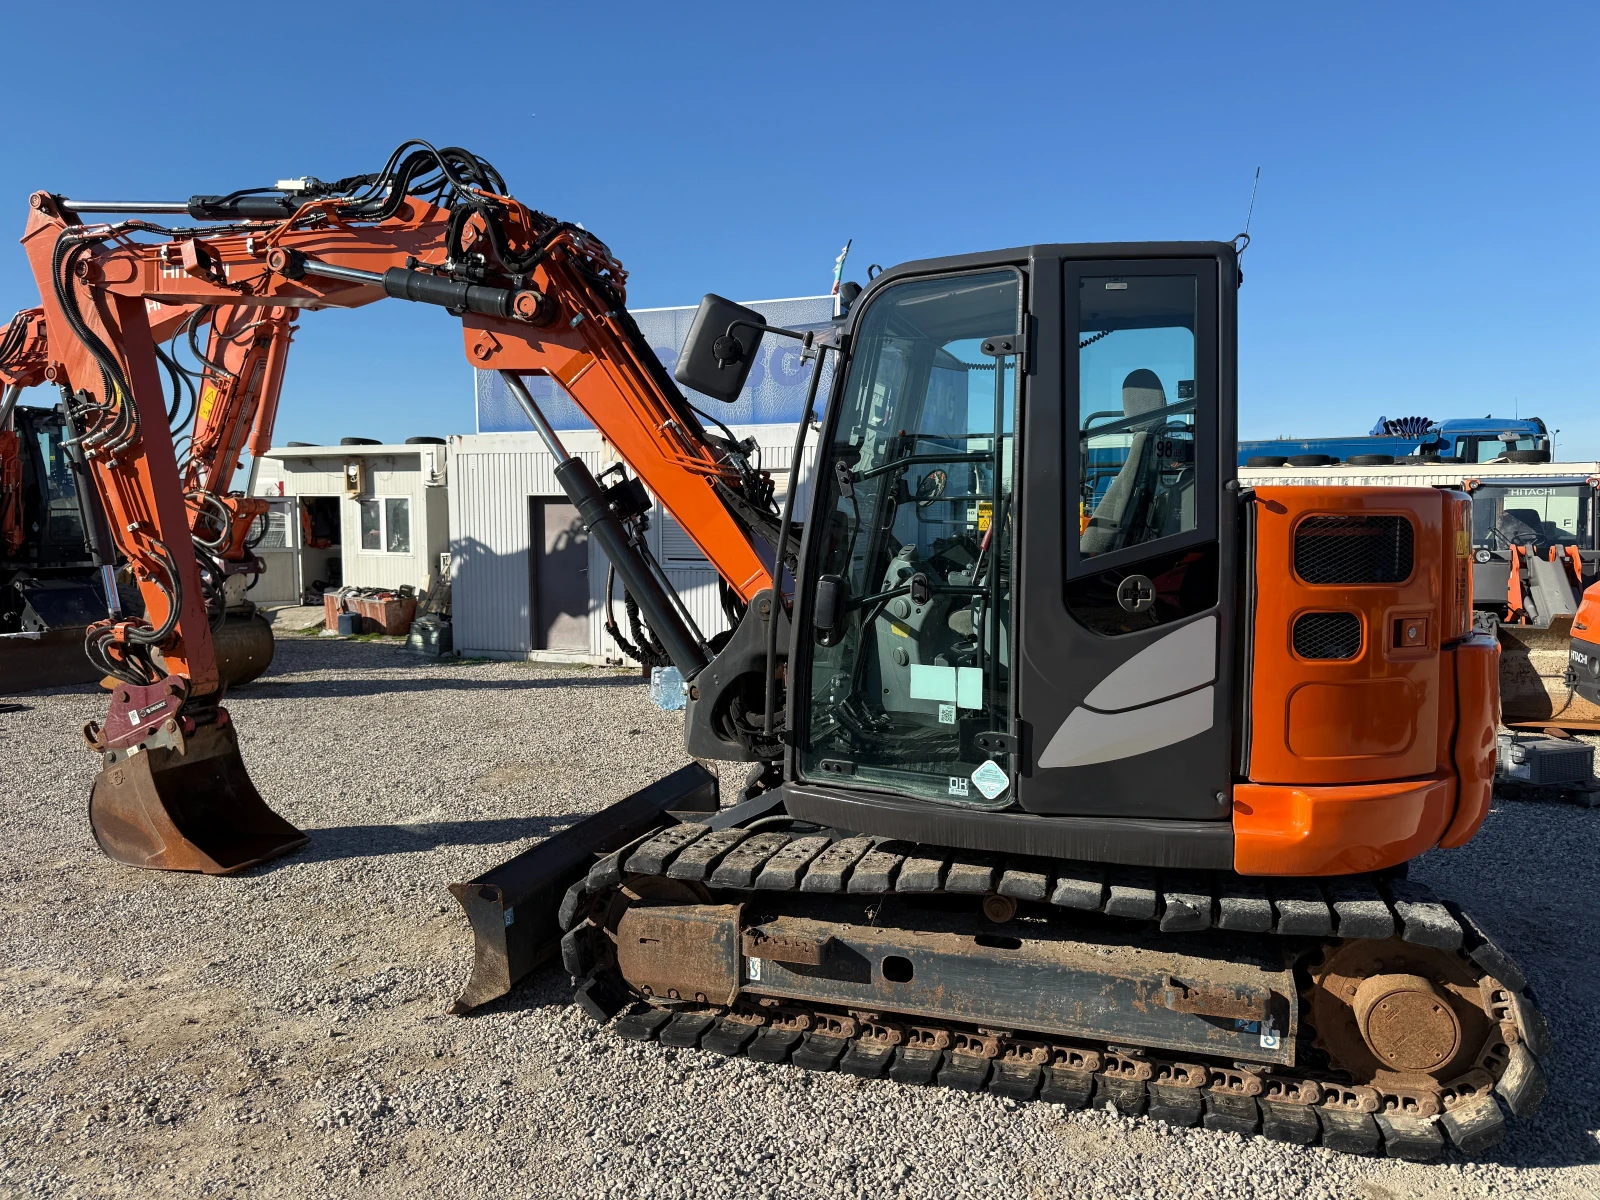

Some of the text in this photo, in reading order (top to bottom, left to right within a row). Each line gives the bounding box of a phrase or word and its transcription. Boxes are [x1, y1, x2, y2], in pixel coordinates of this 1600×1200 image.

[1157, 441, 1172, 458] 98
[1511, 488, 1556, 496] HITACHI
[1571, 650, 1588, 665] HITACHI
